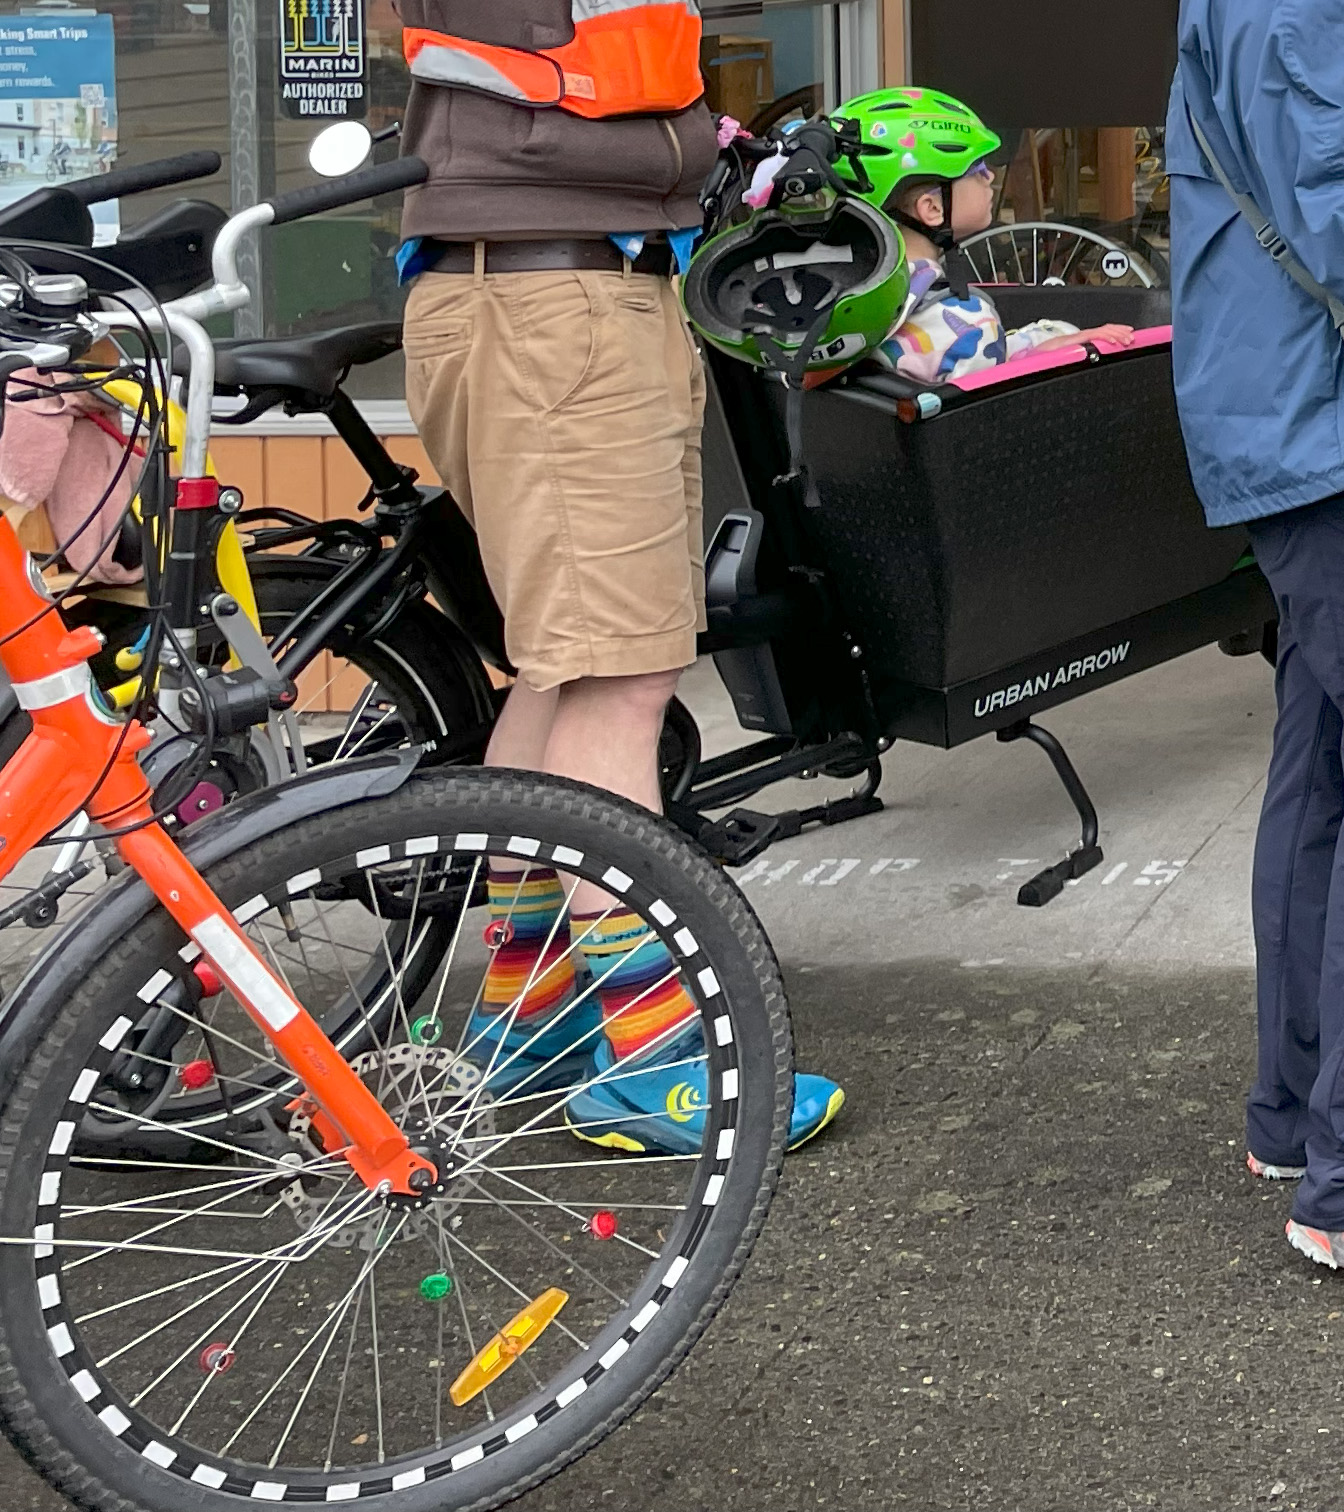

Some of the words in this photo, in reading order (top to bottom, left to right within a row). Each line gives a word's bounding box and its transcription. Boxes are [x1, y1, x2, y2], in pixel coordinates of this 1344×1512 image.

[26, 27, 58, 40] Smart
[59, 27, 88, 42] Trips
[288, 58, 356, 71] MARIN
[283, 82, 364, 99] AUTHORIZED
[299, 98, 348, 115] DEALER
[931, 120, 972, 134] GIRO
[974, 671, 1050, 718] URBAN
[1051, 640, 1131, 688] ARROW
